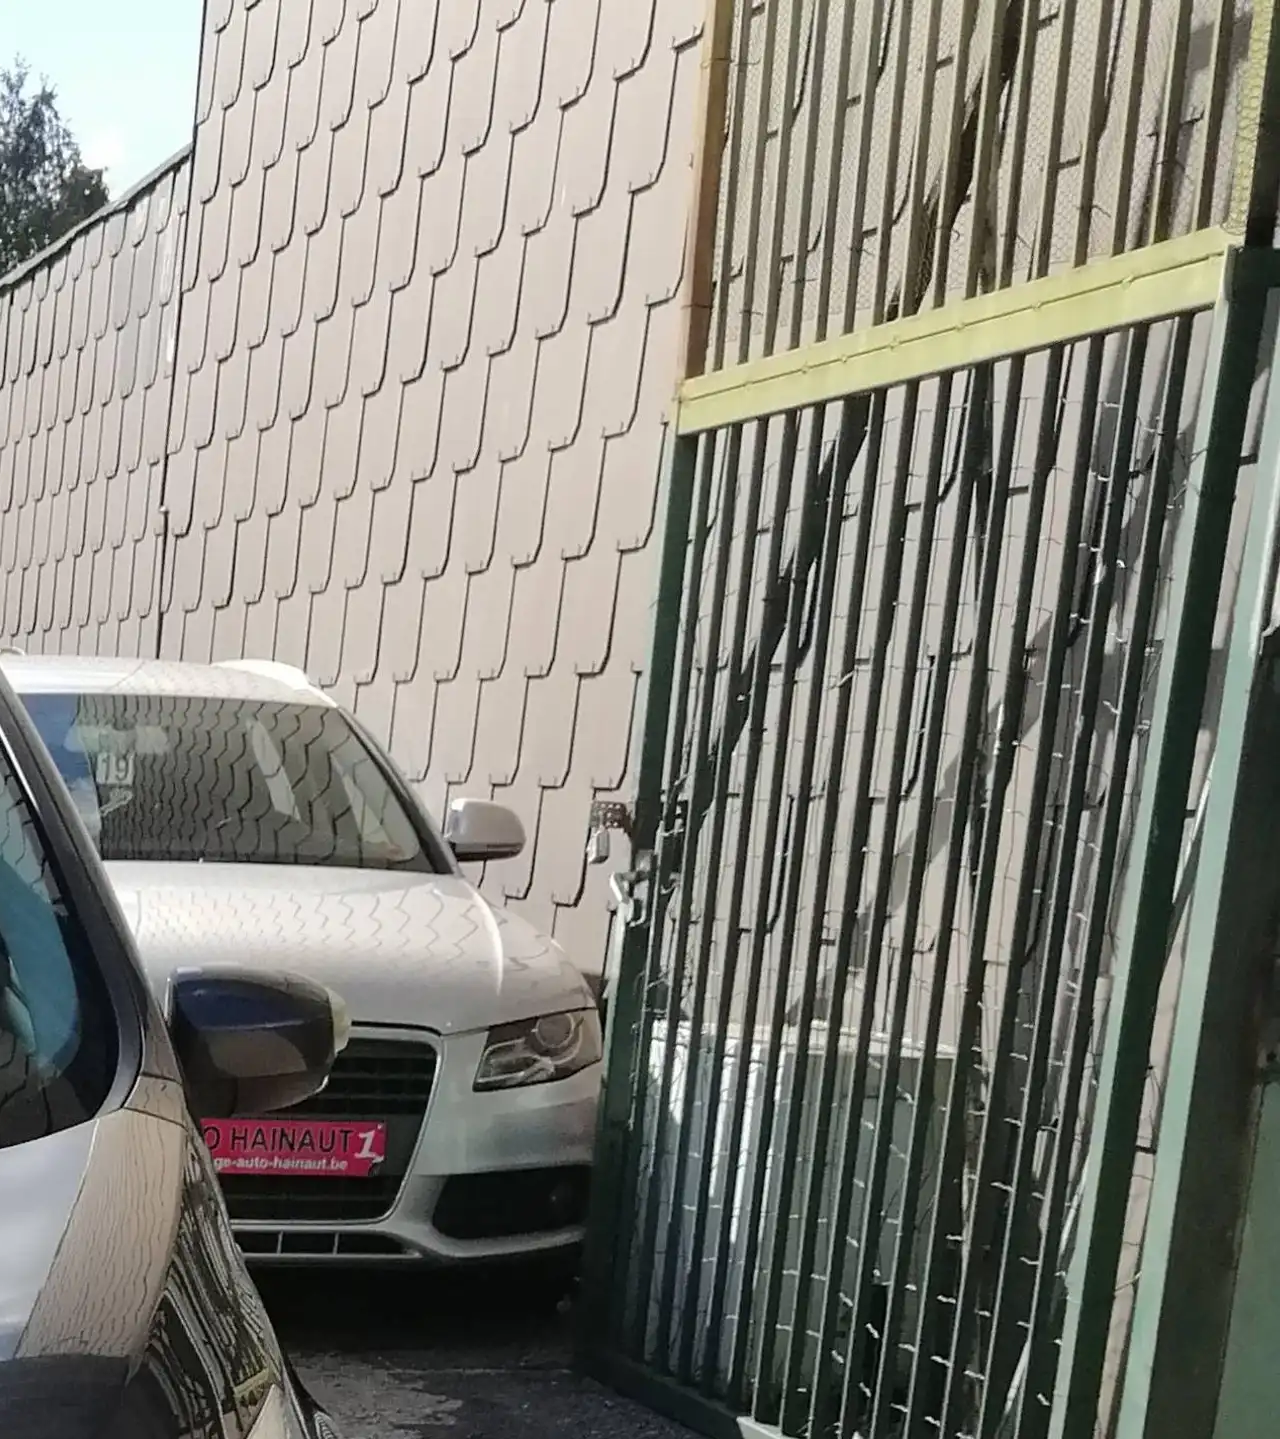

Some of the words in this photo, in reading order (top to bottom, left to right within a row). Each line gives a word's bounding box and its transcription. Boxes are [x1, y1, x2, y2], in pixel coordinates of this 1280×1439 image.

[231, 1127, 354, 1153] HAINAUT
[354, 1130, 380, 1160] 1
[214, 1155, 349, 1172] ge-auto-hainaut.be
